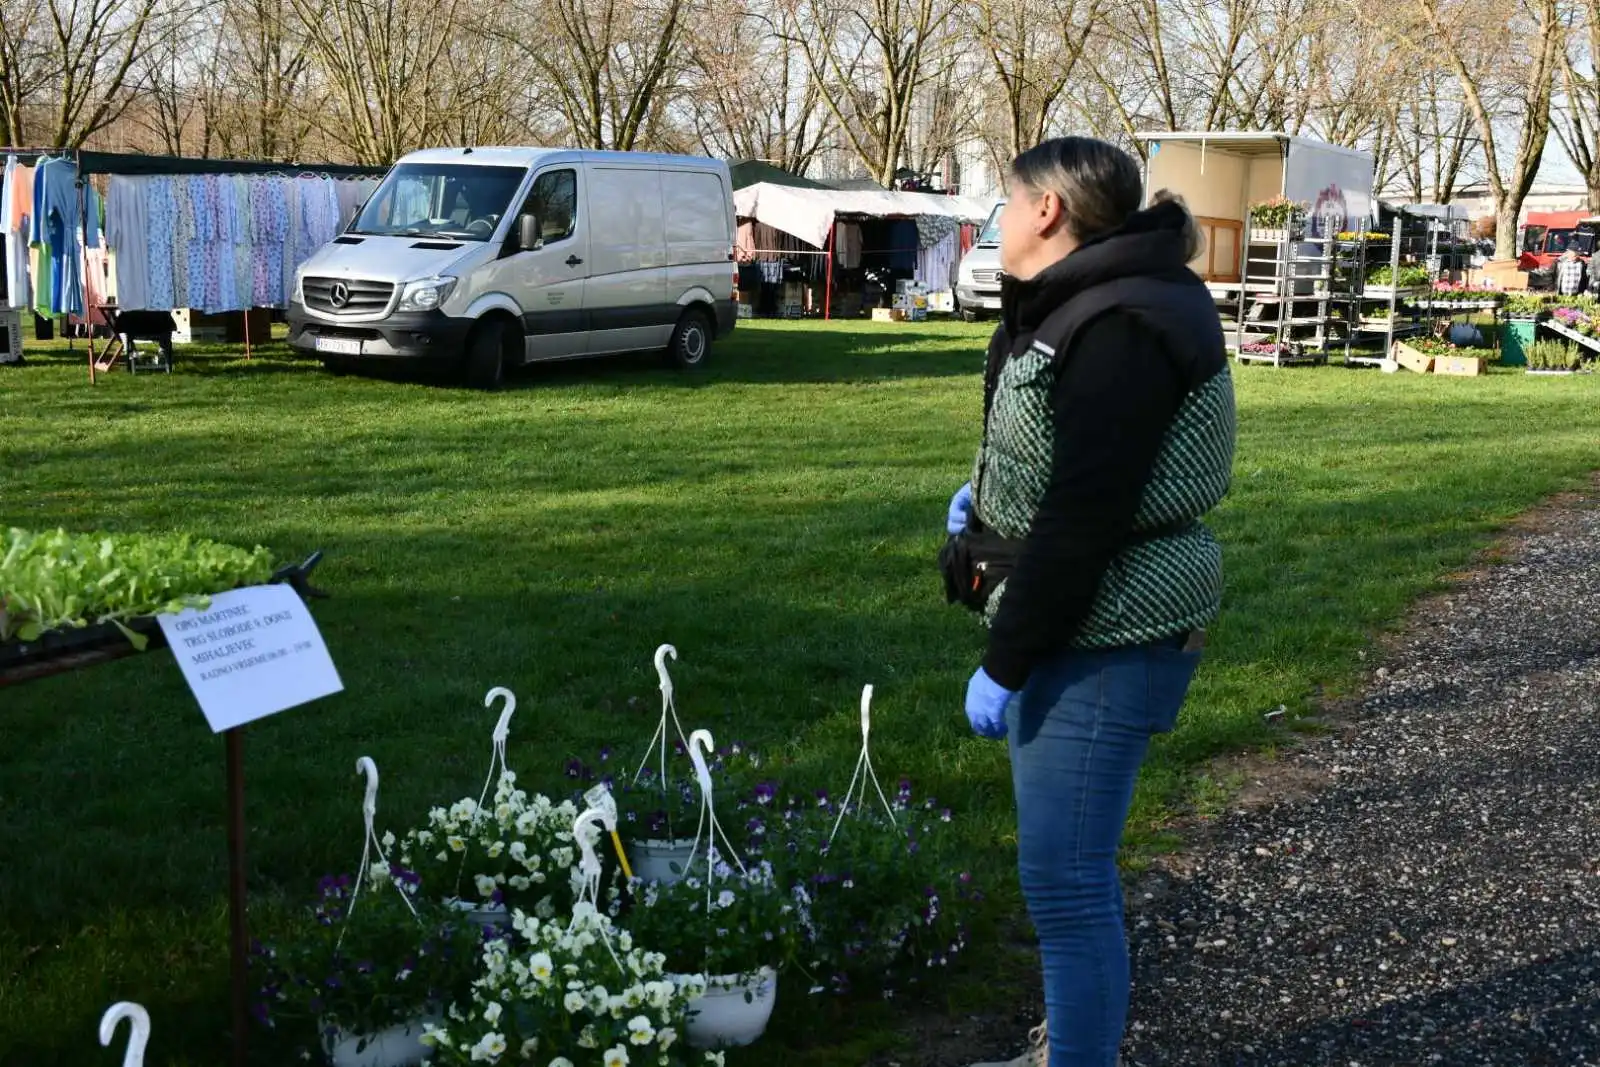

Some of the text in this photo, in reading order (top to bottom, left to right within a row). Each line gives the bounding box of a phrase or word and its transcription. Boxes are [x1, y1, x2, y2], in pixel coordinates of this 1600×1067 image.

[198, 604, 251, 624] MARTINEC
[183, 635, 207, 648] TRG
[206, 620, 254, 641] SLOBODE
[192, 639, 256, 665] MIHALJEVEC
[200, 664, 233, 681] RADNO
